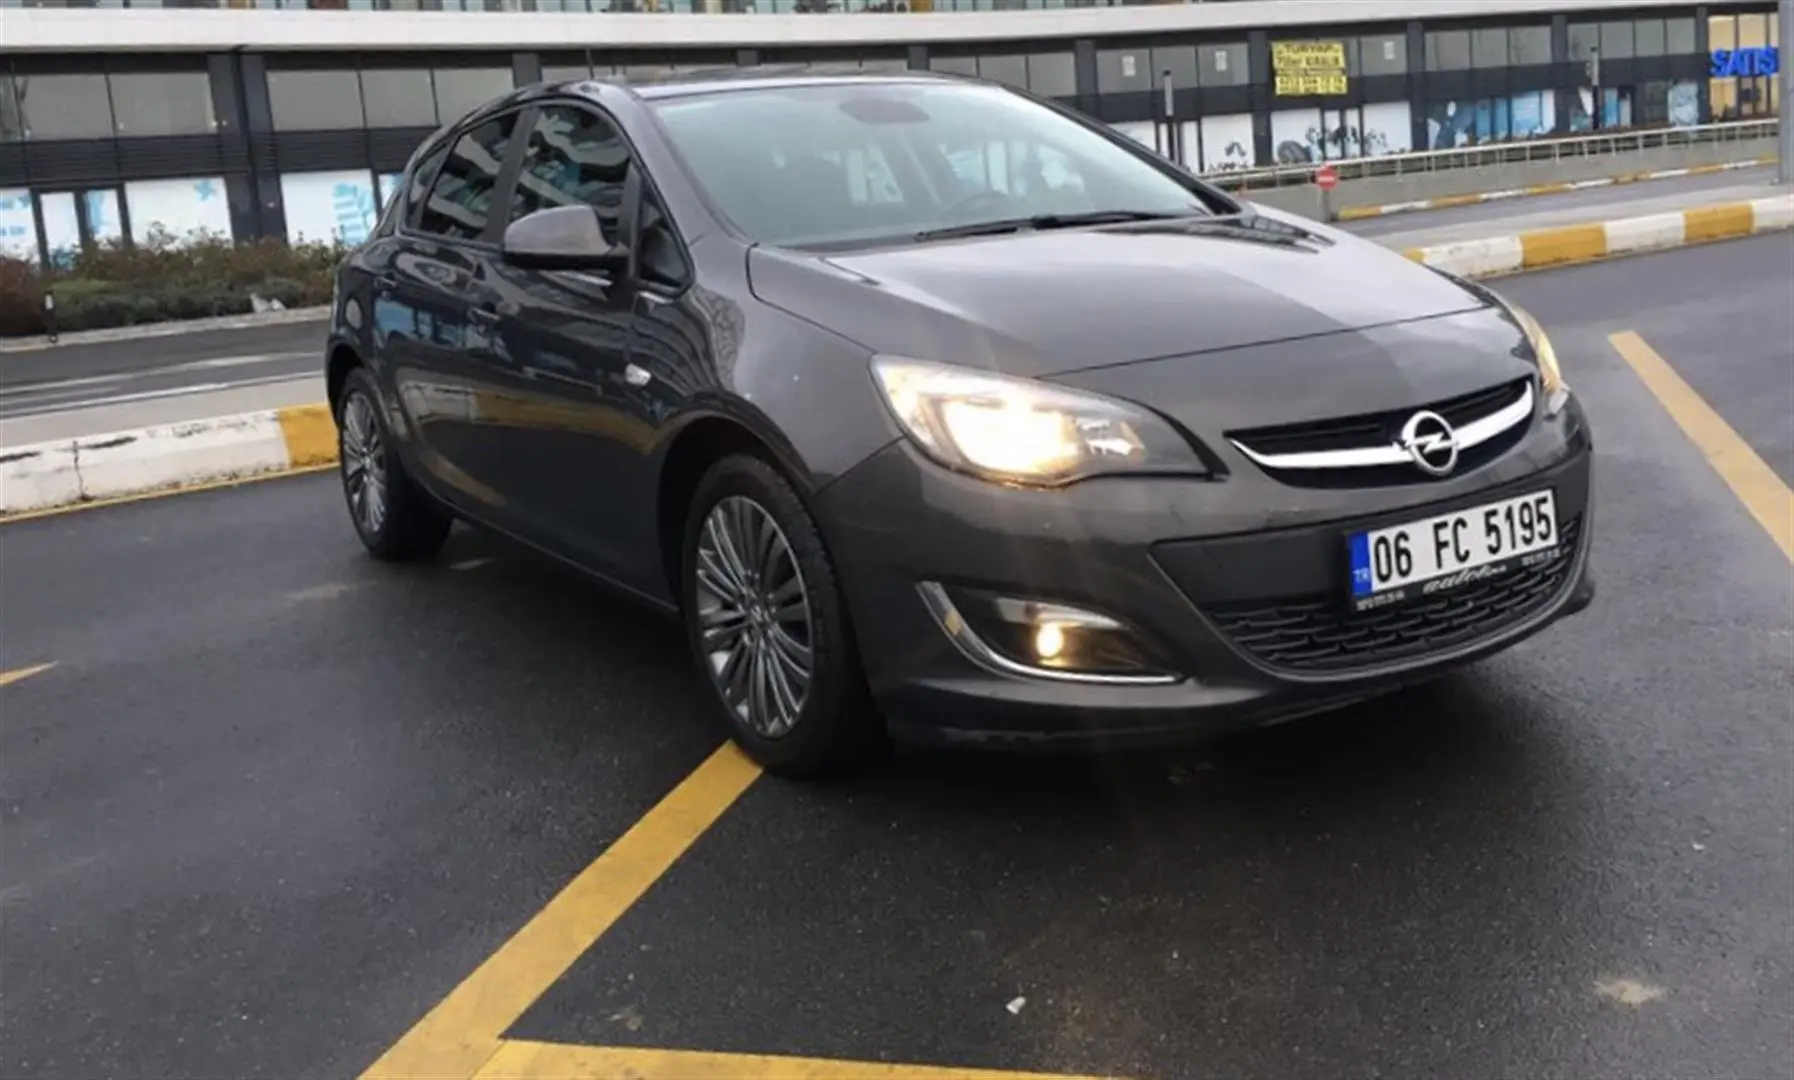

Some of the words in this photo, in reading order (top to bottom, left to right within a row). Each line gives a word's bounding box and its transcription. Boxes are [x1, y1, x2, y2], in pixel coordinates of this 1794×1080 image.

[1373, 531, 1413, 583] 06
[1433, 517, 1470, 569] FC
[1483, 496, 1551, 555] 5195
